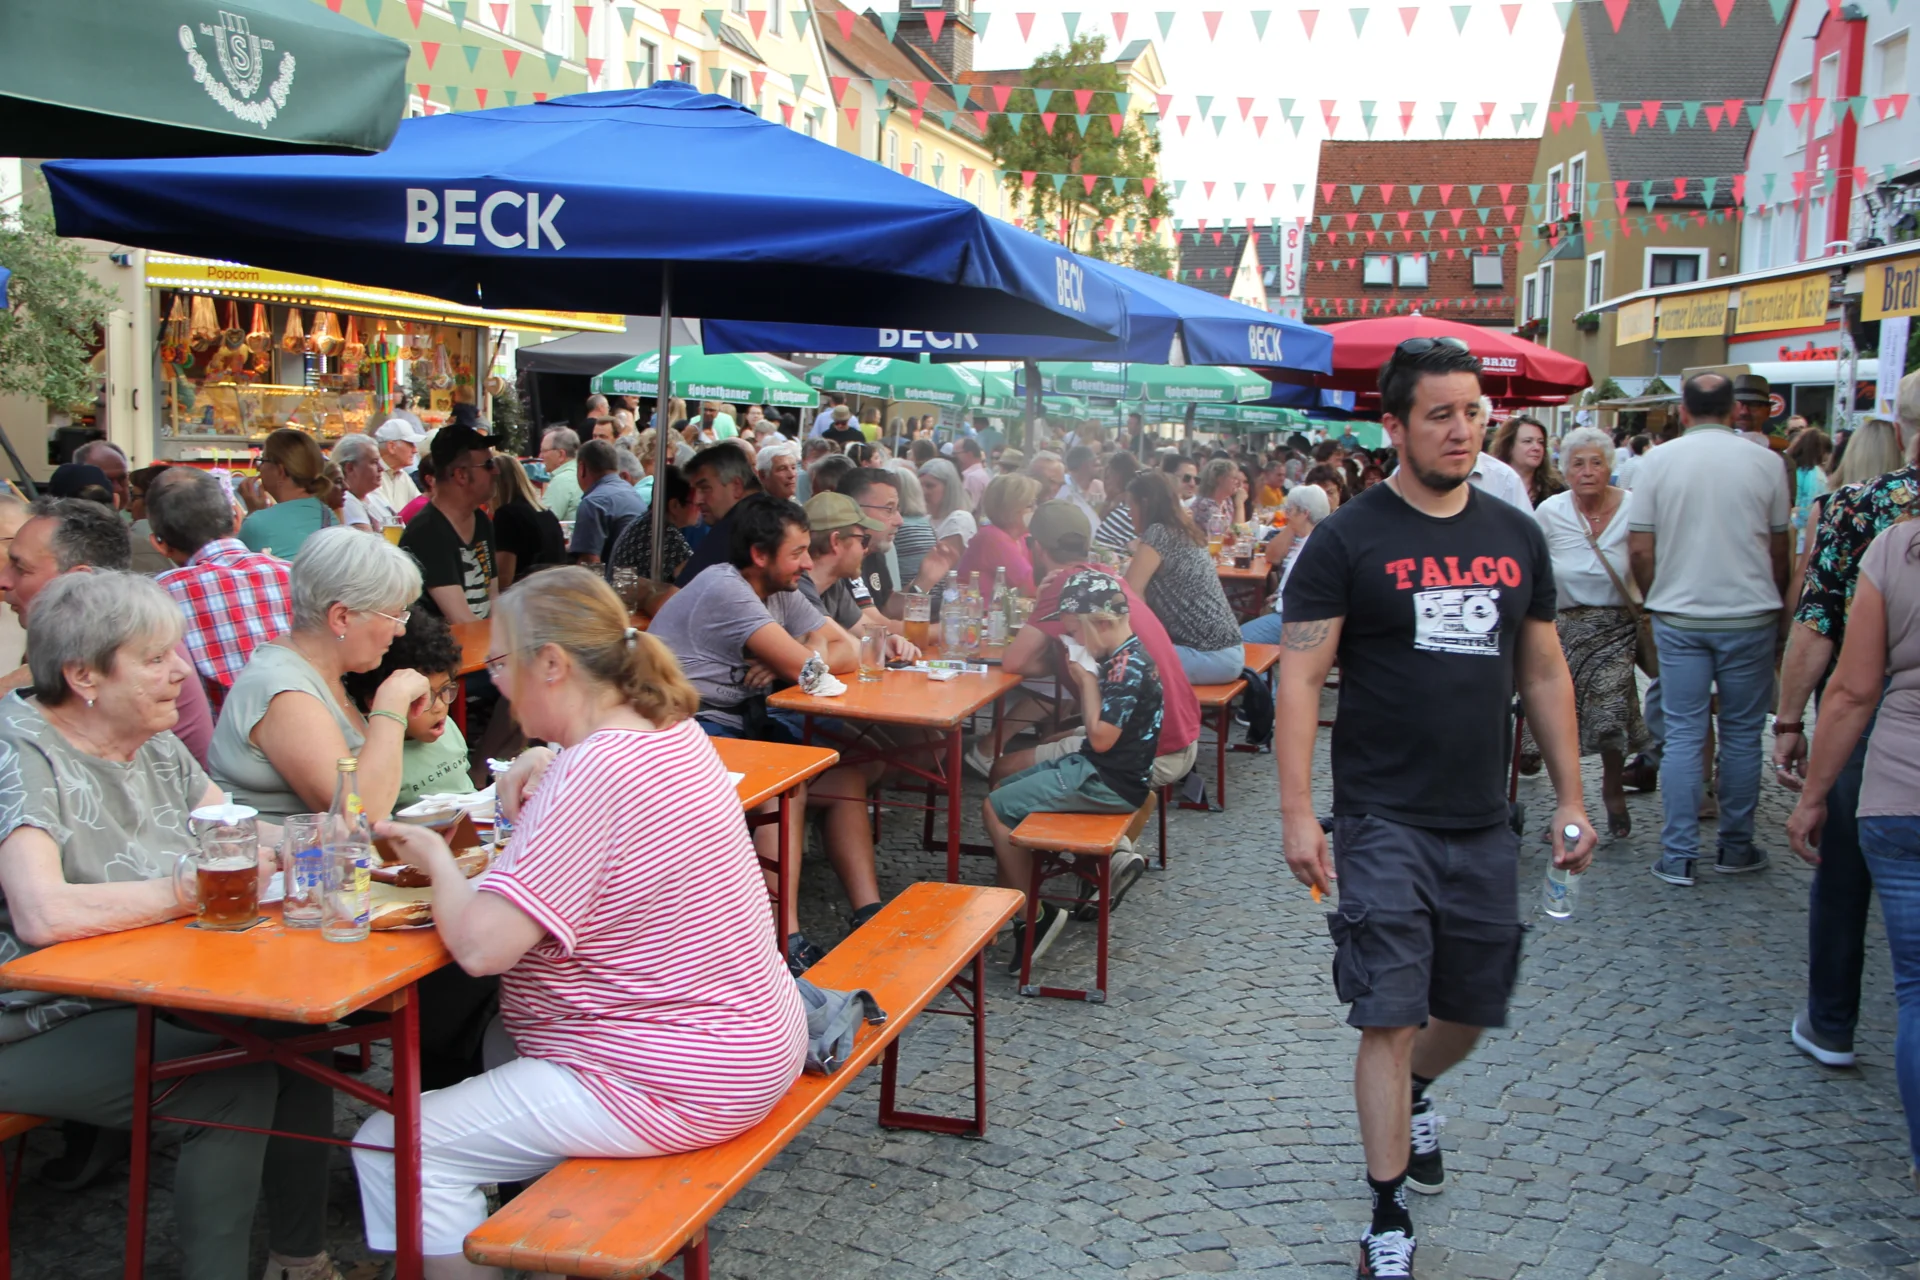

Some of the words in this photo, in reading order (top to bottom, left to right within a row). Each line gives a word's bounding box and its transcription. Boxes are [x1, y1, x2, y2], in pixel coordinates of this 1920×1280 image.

[405, 188, 567, 251] BECK
[207, 266, 260, 281] Popcorn
[1055, 256, 1086, 312] BECK
[1798, 278, 1826, 319] Käse
[1248, 325, 1283, 362] BECK
[1385, 555, 1521, 590] TALCO
